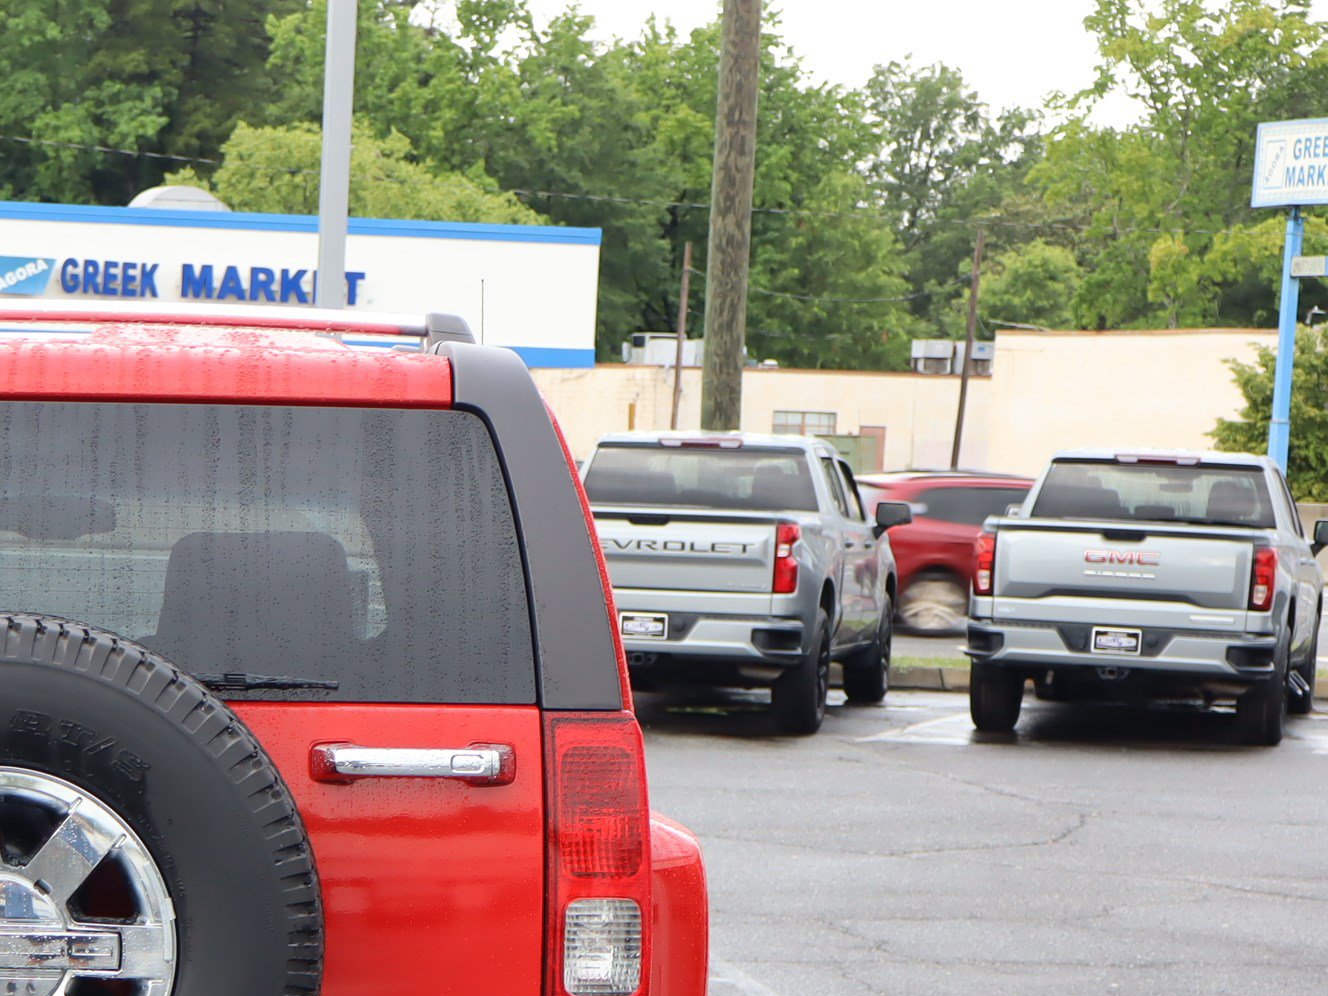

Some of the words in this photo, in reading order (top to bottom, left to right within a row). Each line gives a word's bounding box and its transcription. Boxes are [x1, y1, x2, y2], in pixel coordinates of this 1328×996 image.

[60, 257, 160, 299] GREEK
[180, 263, 366, 306] MARKT
[1084, 550, 1160, 566] GMC
